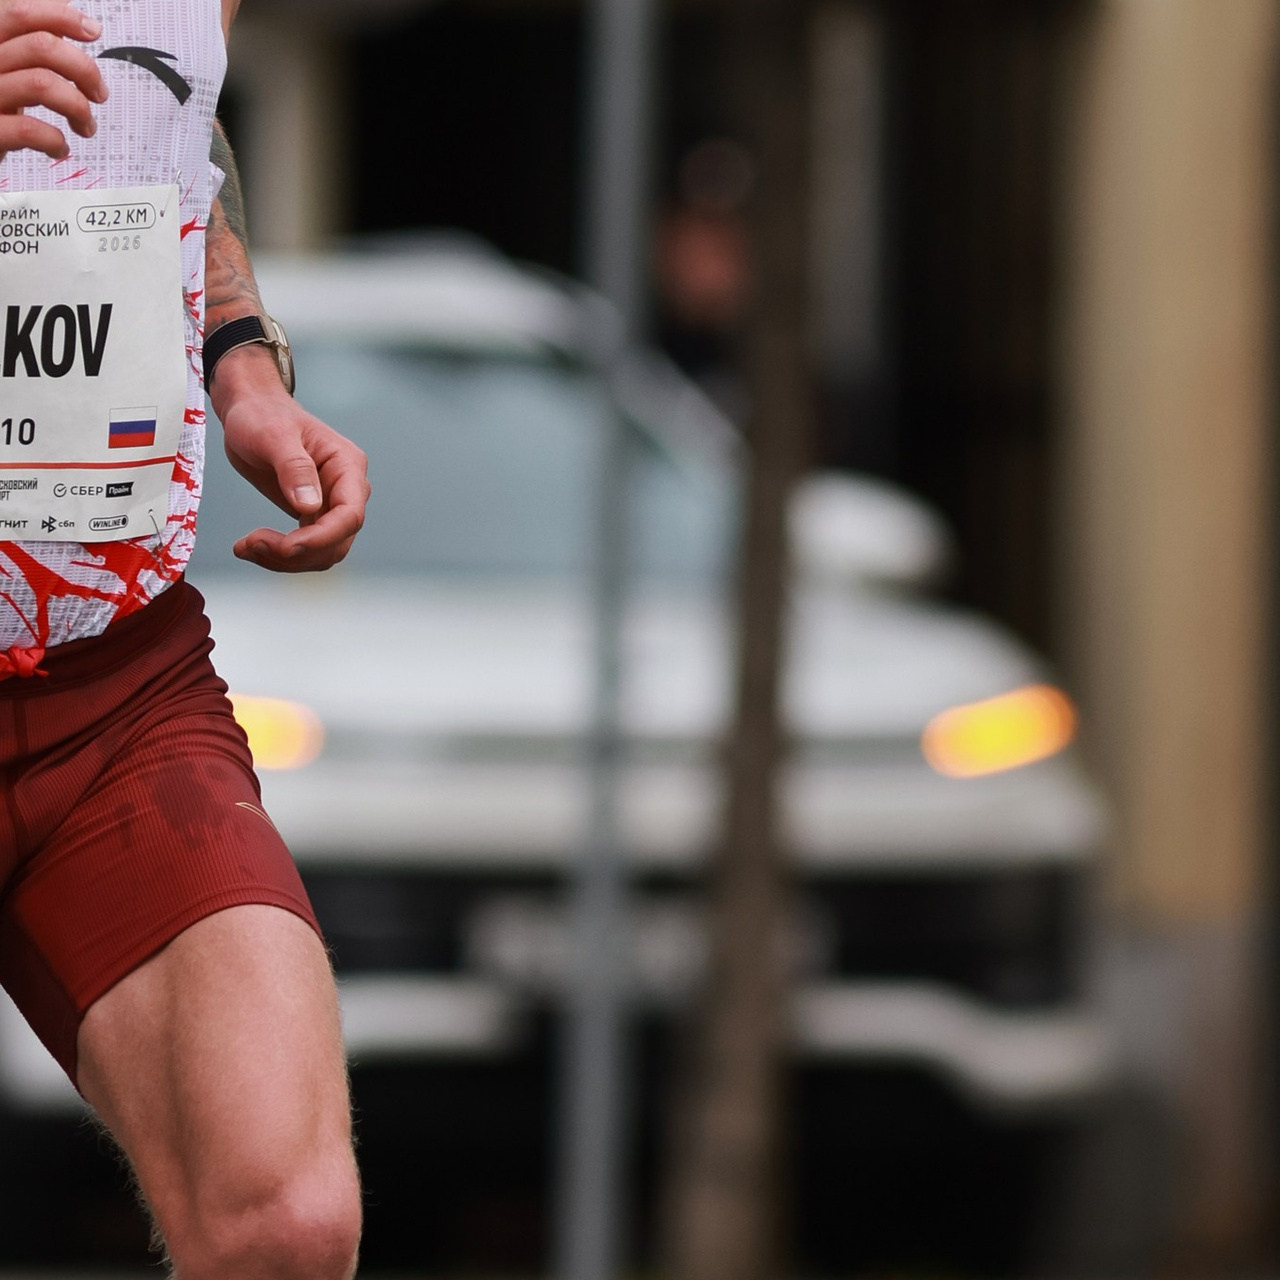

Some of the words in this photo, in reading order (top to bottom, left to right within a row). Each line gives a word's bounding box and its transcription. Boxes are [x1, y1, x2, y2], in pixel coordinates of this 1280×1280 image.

[86, 209, 121, 227] 42,2
[98, 235, 141, 252] 2026
[1, 418, 35, 446] 10
[70, 485, 104, 496] СБЕР
[58, 519, 76, 528] сбп
[92, 518, 122, 529] WINLINE
